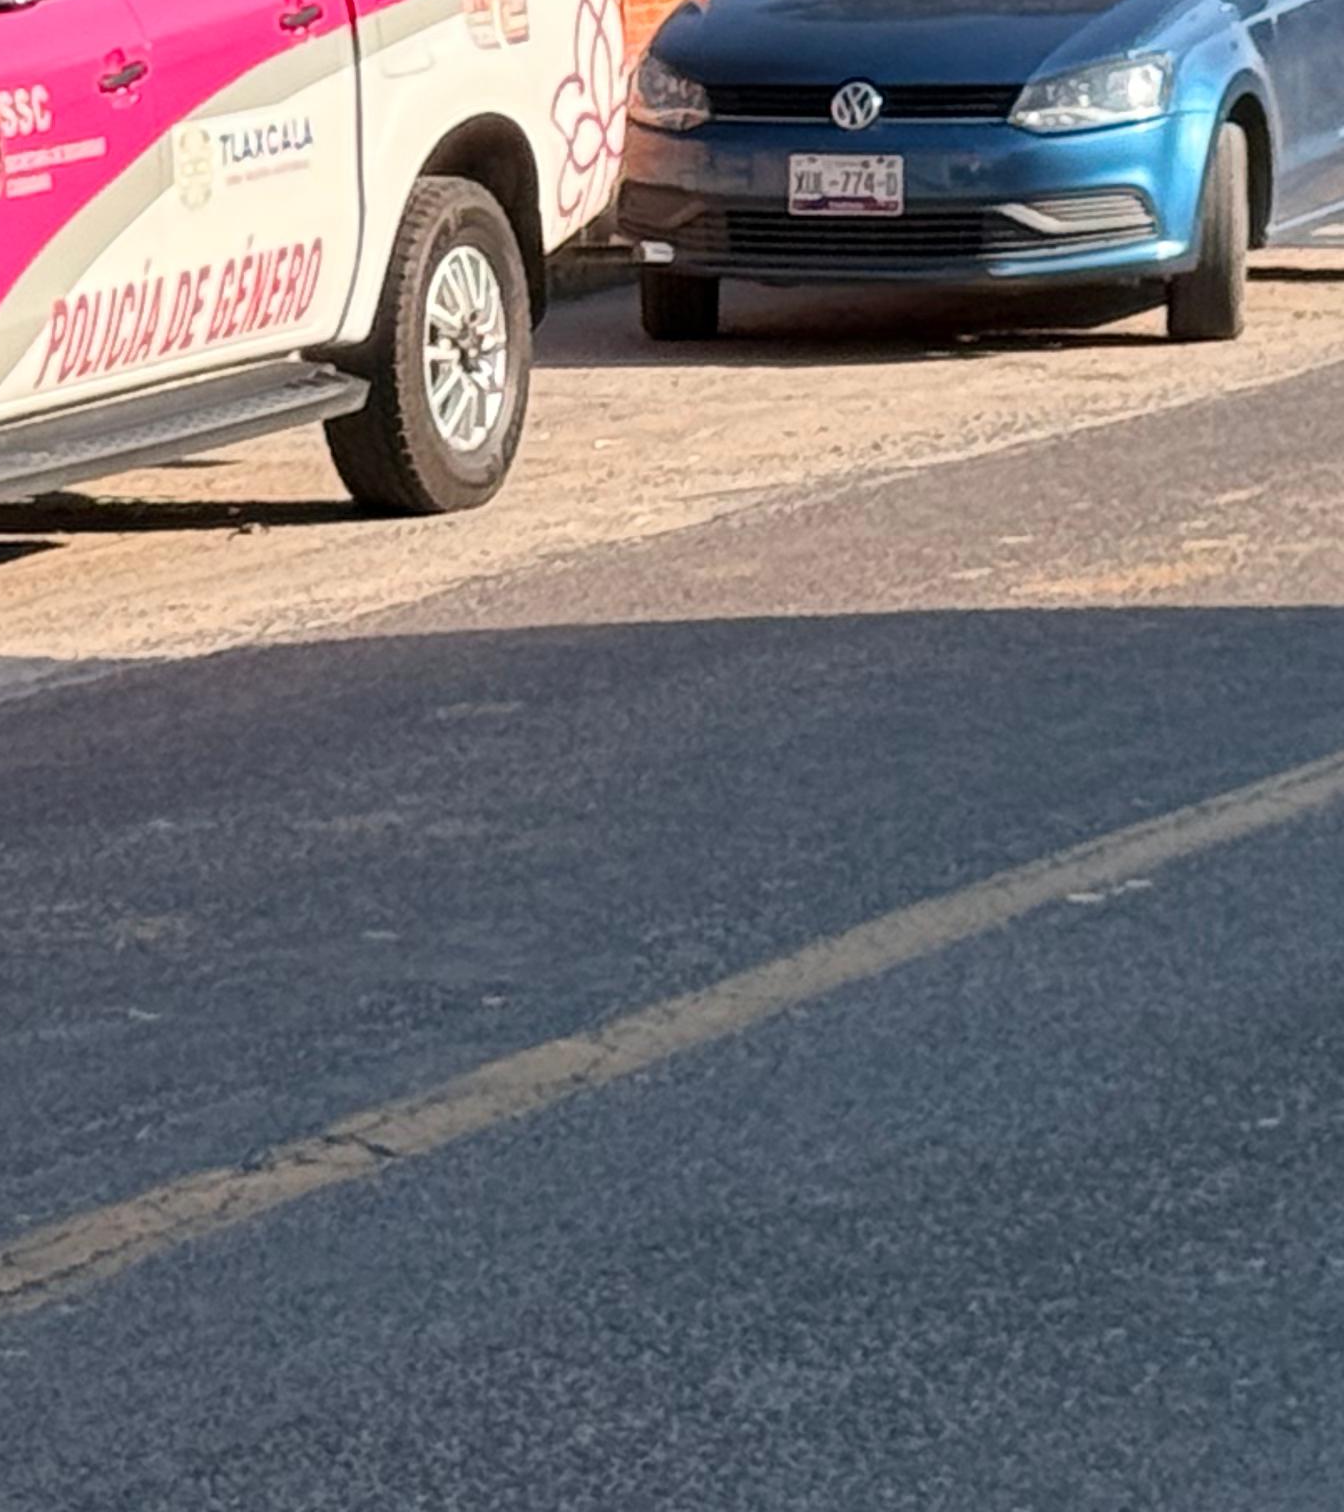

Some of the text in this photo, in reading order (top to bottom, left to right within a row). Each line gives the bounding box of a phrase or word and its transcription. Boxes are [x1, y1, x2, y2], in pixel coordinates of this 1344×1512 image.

[219, 116, 314, 167] TLAXCALA
[33, 233, 324, 388] POLICÍA DE GÉNERO
